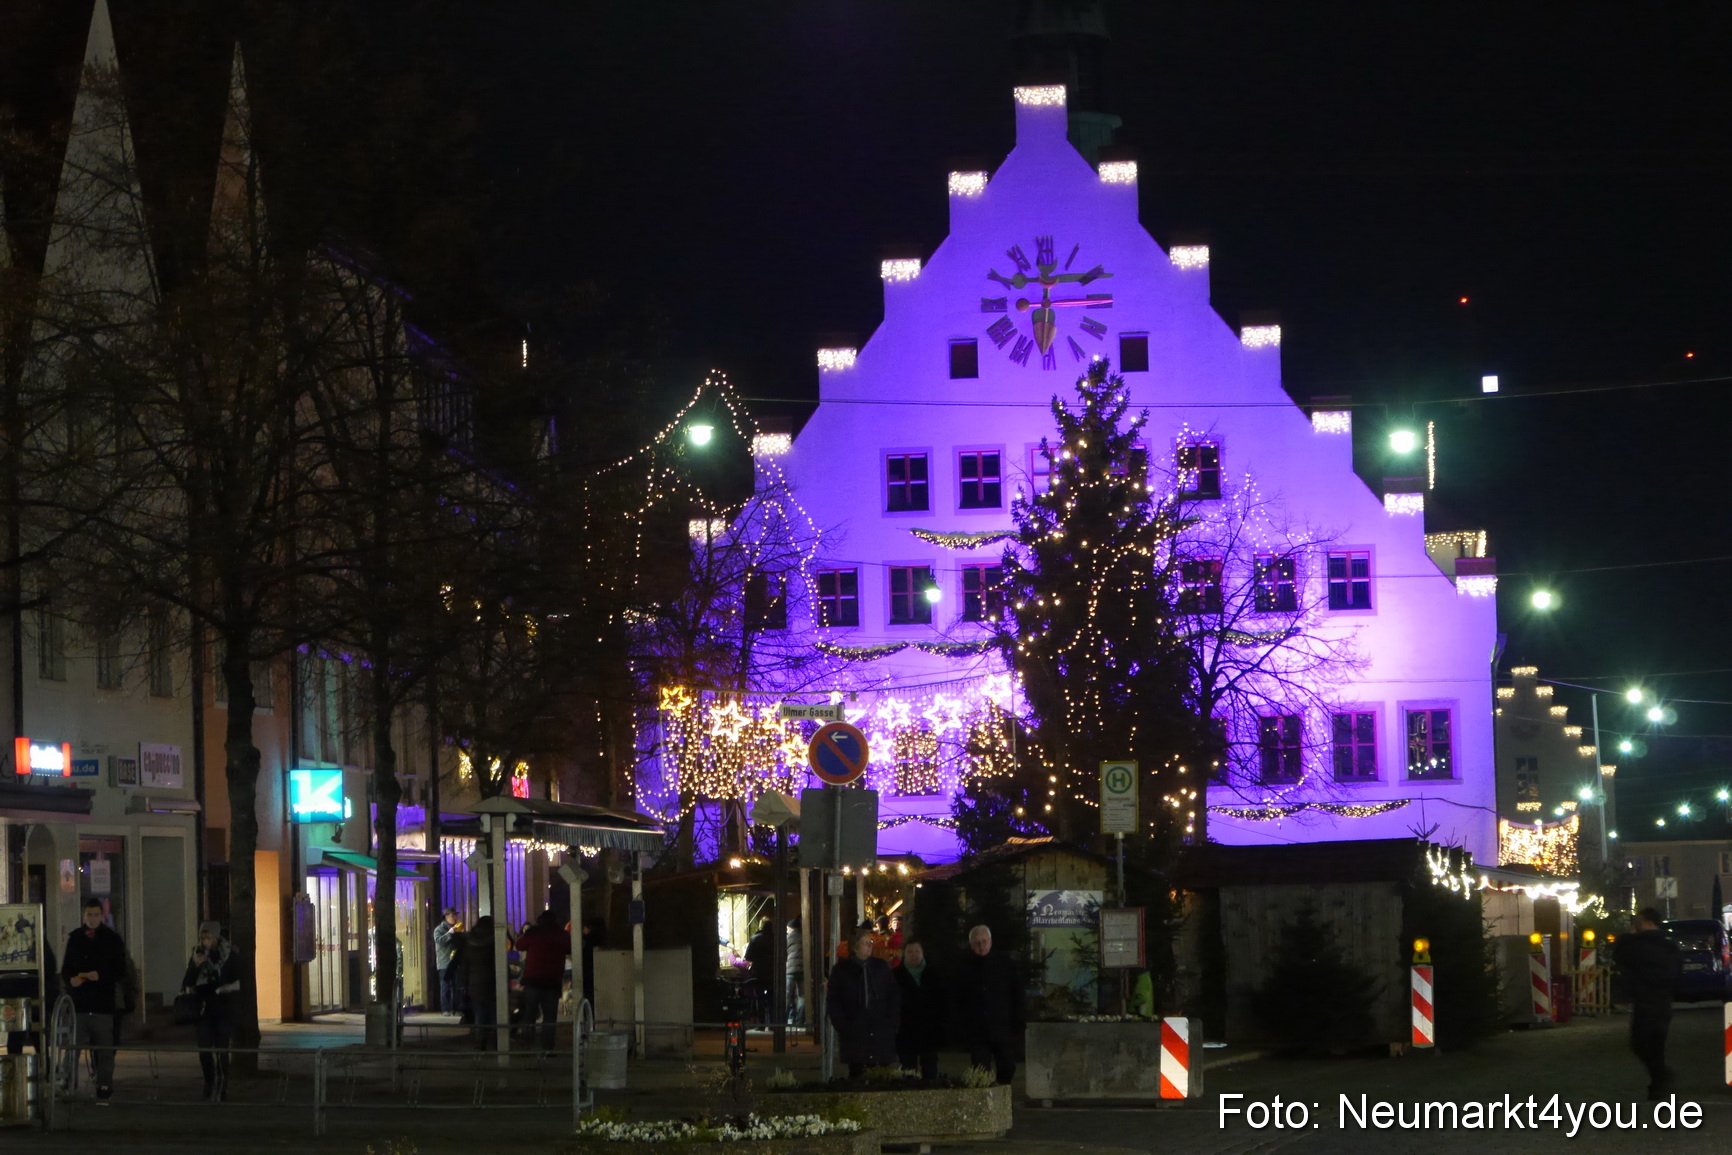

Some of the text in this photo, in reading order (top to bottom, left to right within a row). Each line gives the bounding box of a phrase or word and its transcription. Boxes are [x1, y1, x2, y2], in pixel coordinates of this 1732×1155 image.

[783, 707, 833, 717] Ulmer Gasse
[1112, 773, 1126, 788] H
